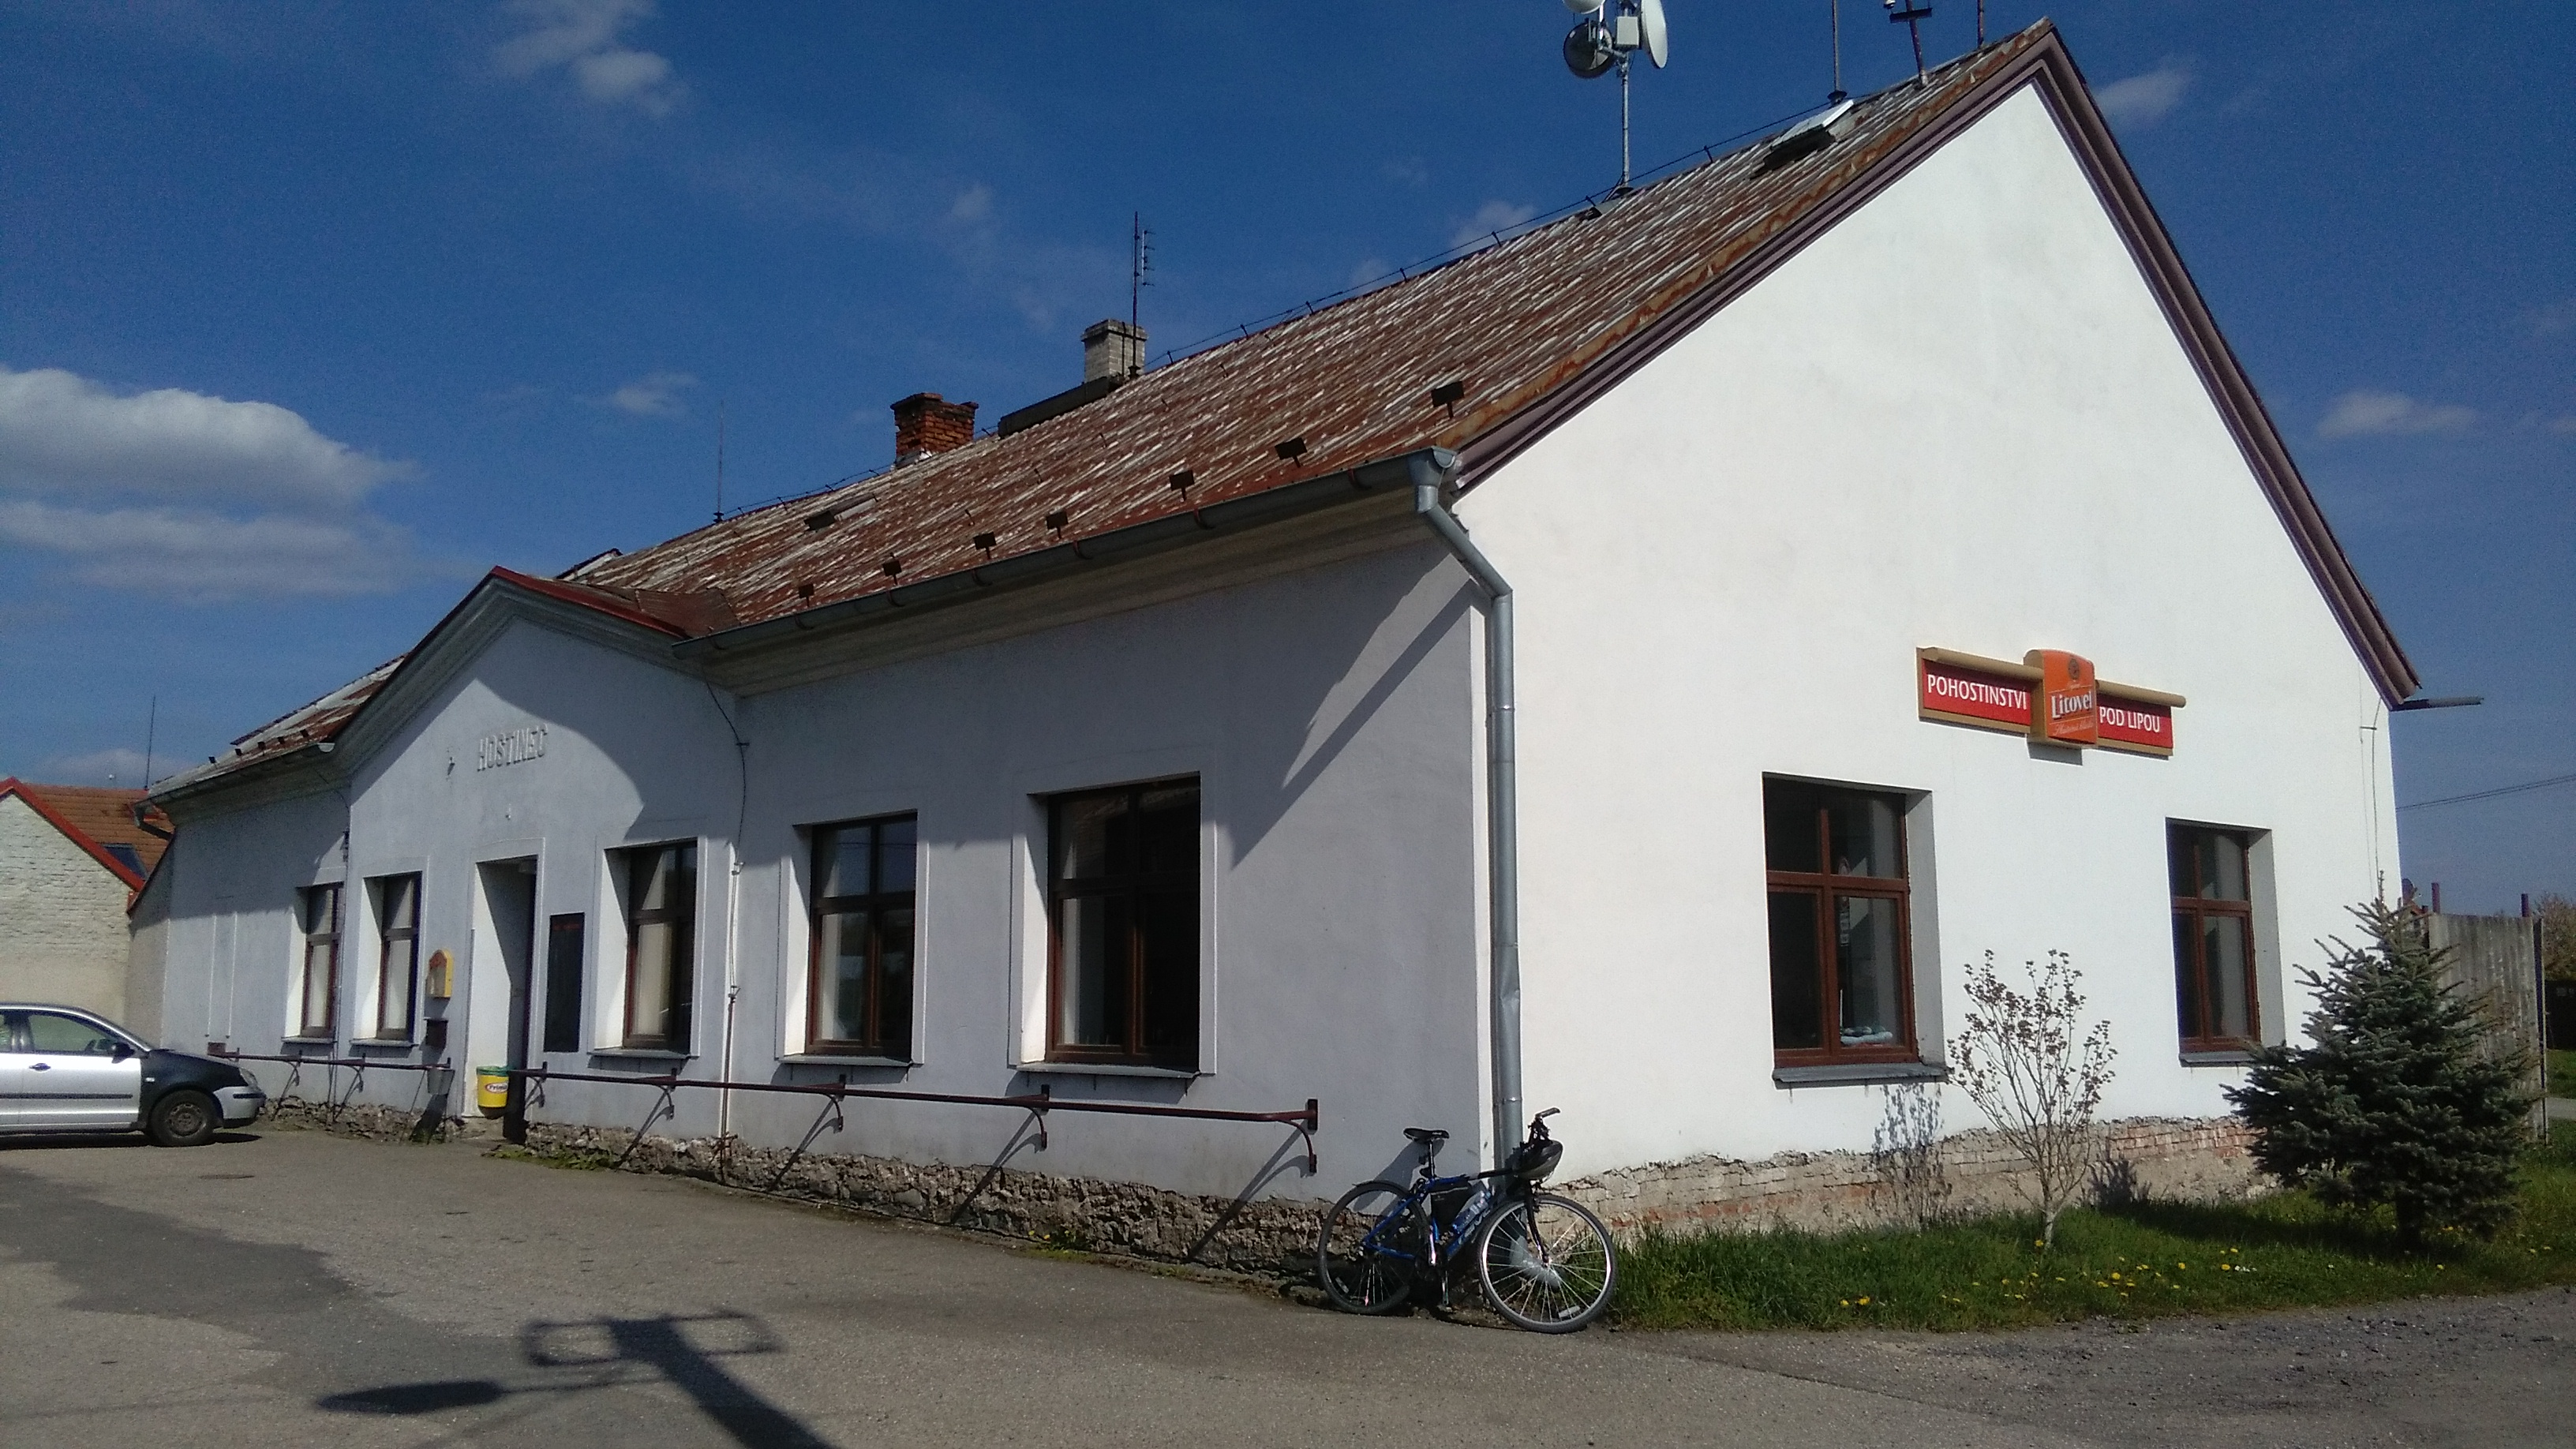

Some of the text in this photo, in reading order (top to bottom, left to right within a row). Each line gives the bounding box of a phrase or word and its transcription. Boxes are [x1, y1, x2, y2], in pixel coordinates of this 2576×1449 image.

[2051, 691, 2092, 719] Litovel
[2099, 706, 2160, 733] POD LIPOU
[477, 722, 548, 772] HOSTINEC
